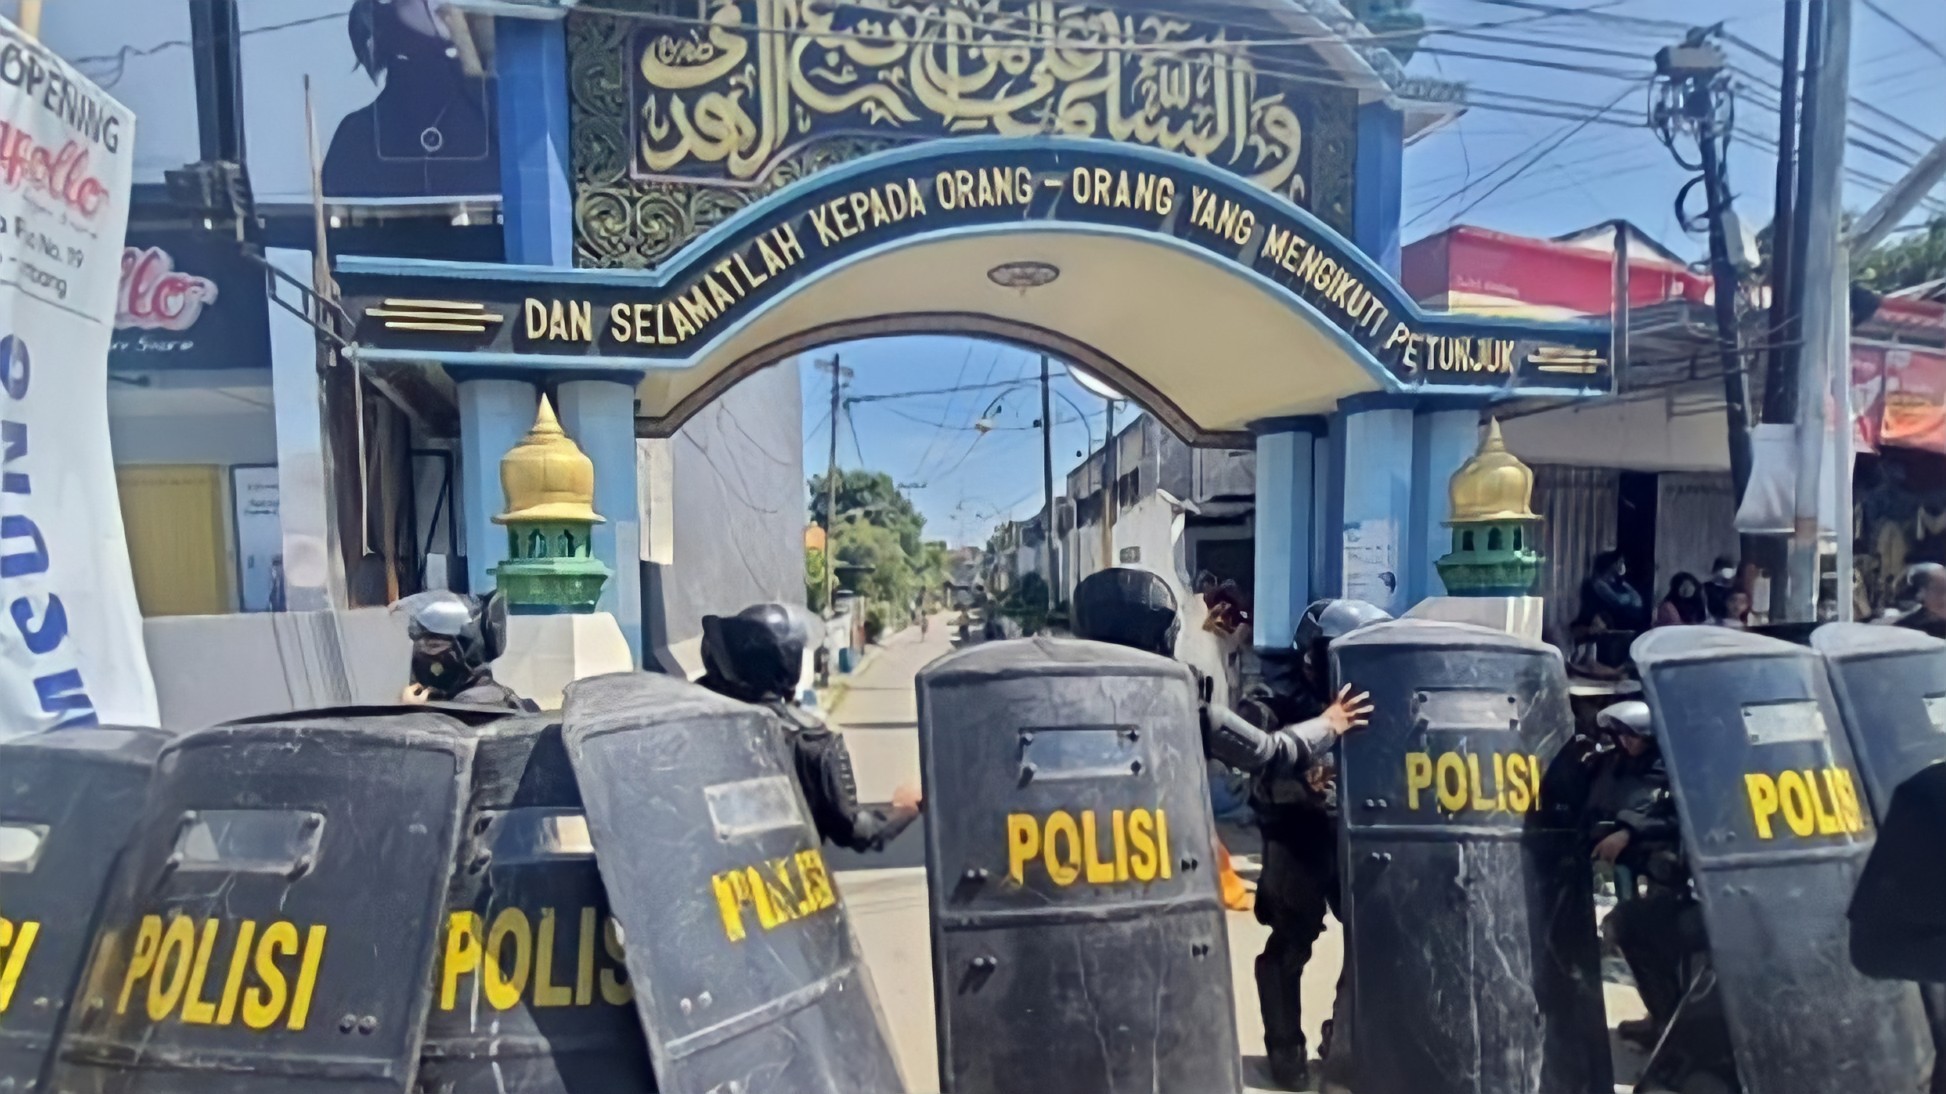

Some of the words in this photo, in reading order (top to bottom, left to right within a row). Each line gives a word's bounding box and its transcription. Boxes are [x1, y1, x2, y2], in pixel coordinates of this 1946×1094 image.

[0, 43, 120, 154] OPENING
[525, 298, 592, 342] DAN
[611, 222, 805, 345] SELAMATLAH
[809, 177, 927, 247] KEPADA
[935, 167, 1033, 210] ORANG
[1072, 166, 1176, 216] ORANG
[1189, 185, 1257, 246] YANG
[1260, 223, 1389, 338] MENGIKUTI
[1384, 321, 1515, 374] PETUNJUK
[1404, 751, 1542, 813] POLISI
[1007, 807, 1172, 888] POLISI
[116, 914, 327, 1030] POLISI
